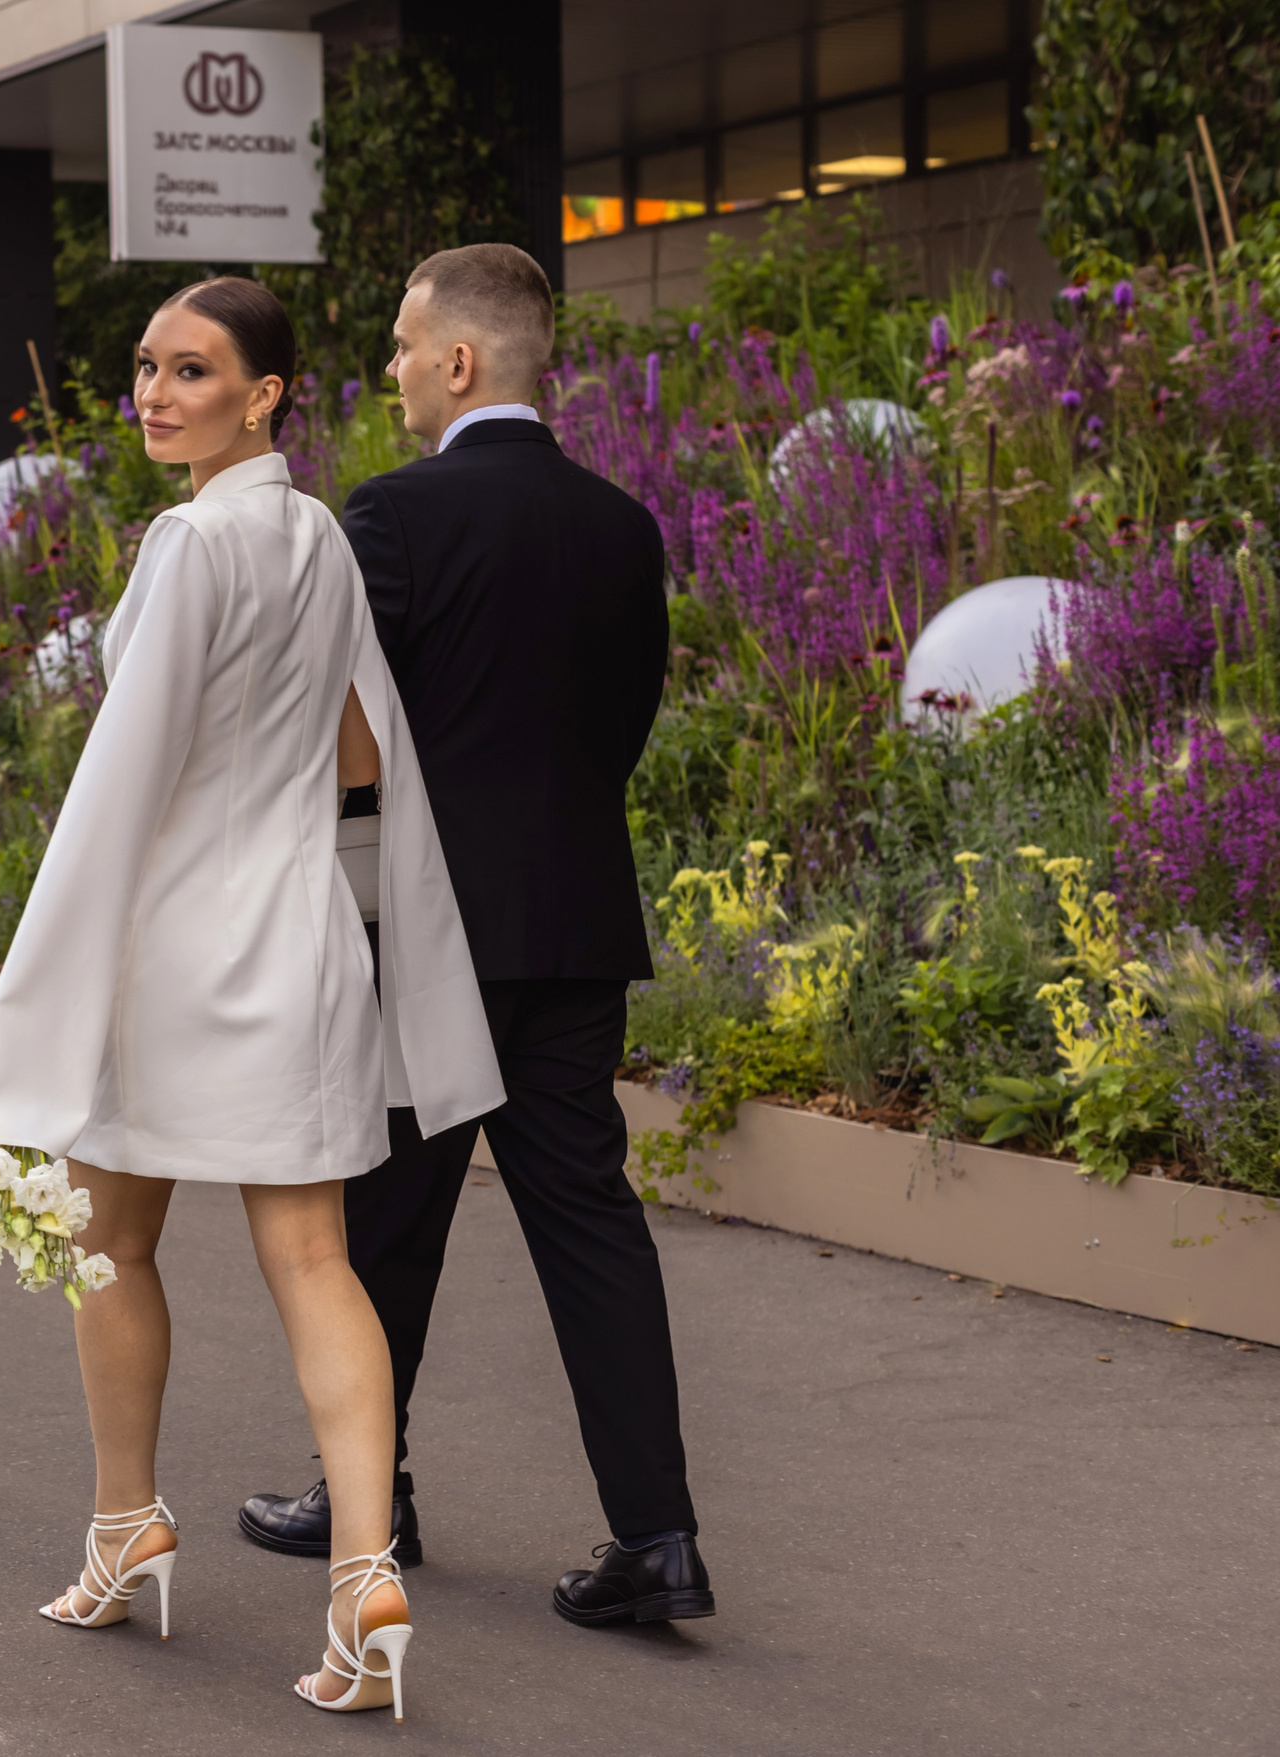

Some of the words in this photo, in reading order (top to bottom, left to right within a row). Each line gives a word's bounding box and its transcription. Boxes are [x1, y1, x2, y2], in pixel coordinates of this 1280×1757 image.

[154, 132, 202, 151] ЗАГС
[206, 134, 296, 154] МОСКВЫ
[154, 173, 218, 196] Дворец
